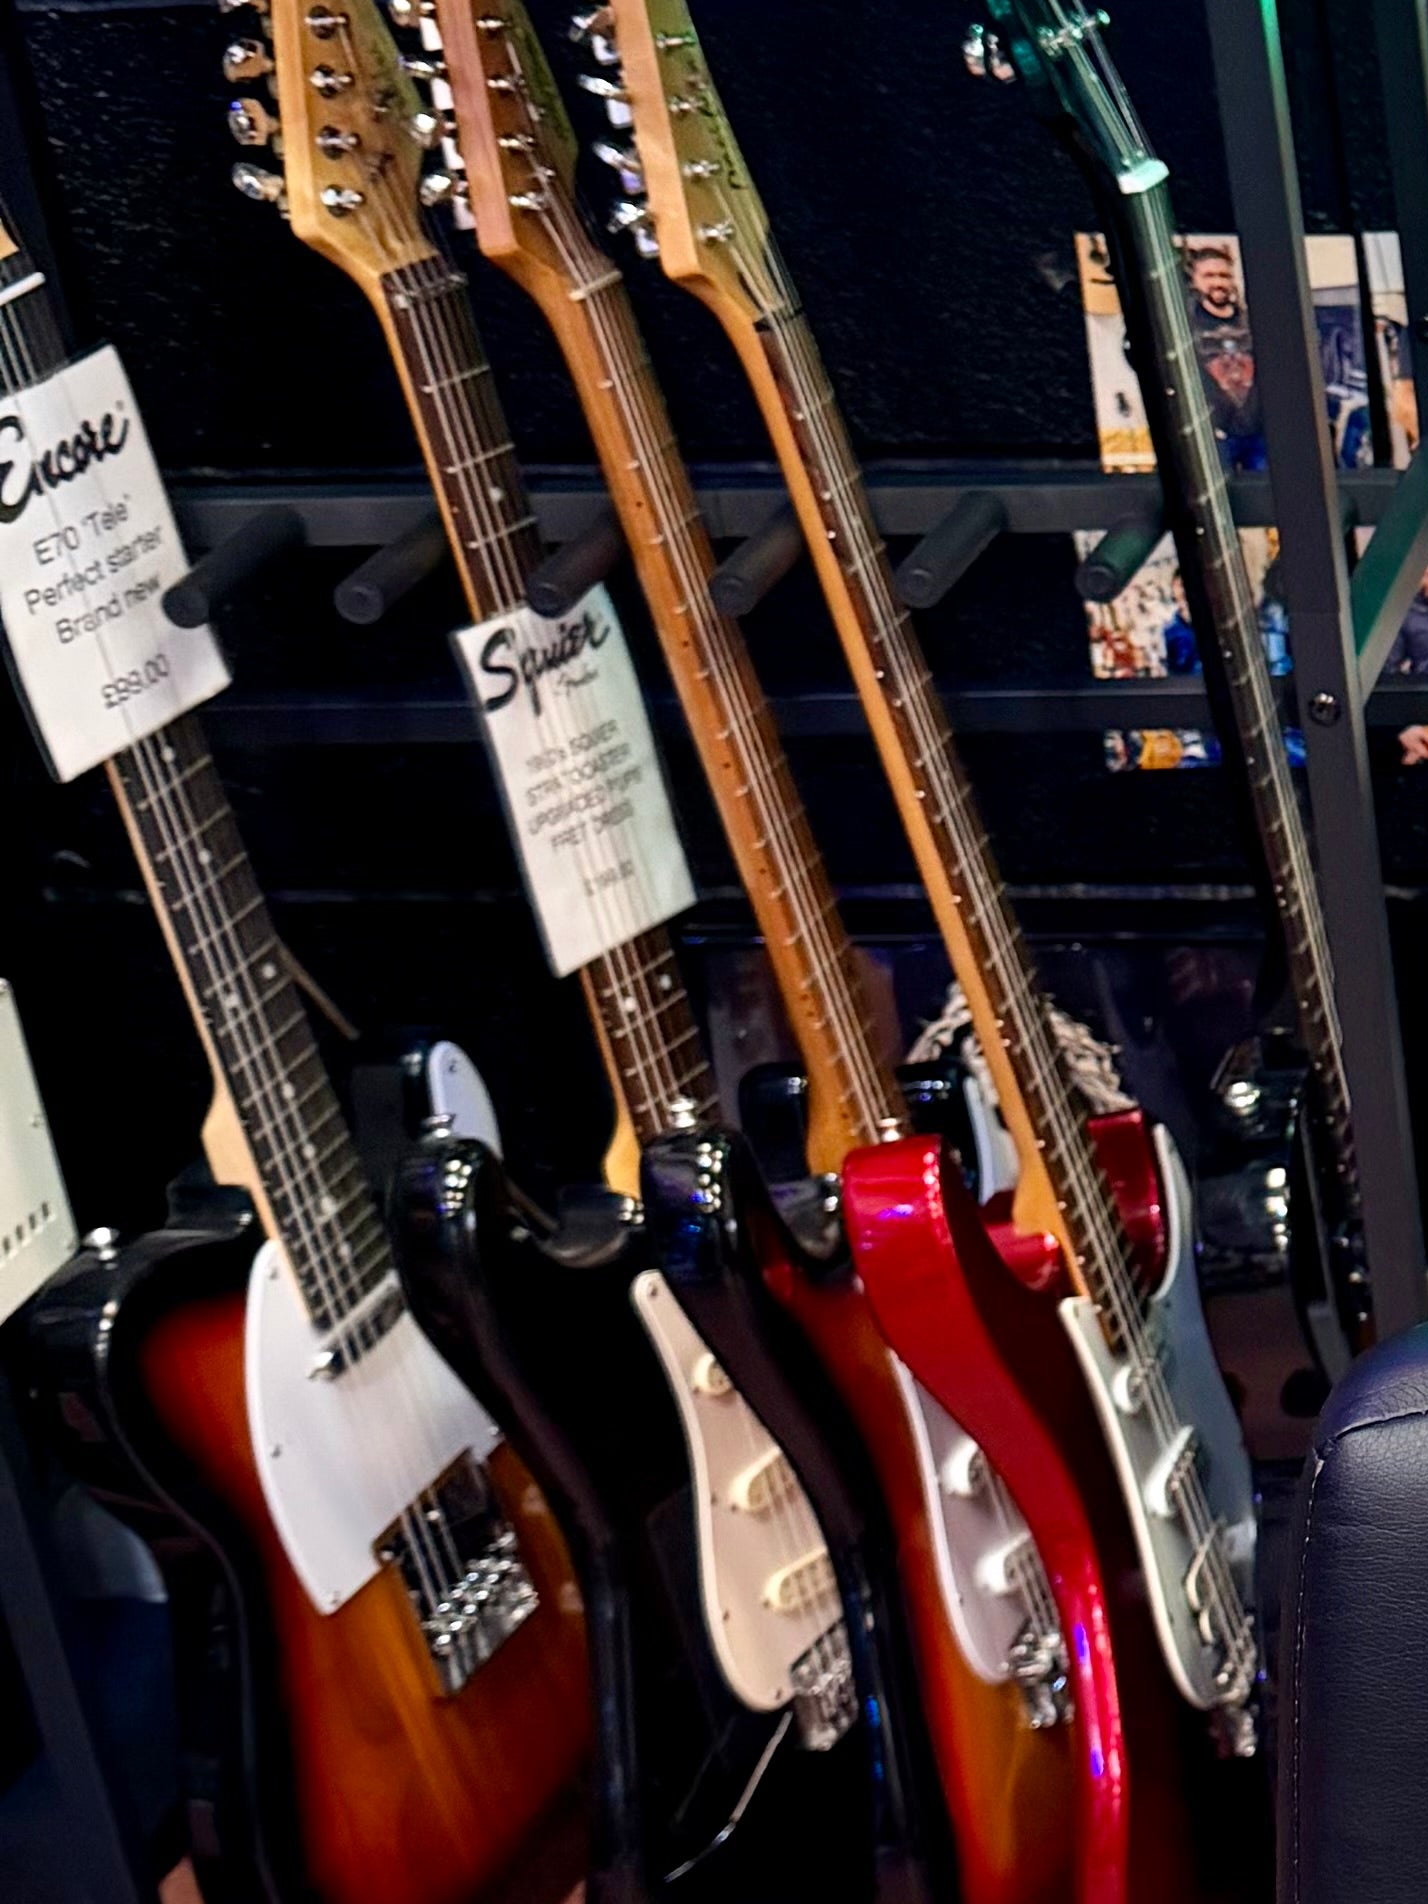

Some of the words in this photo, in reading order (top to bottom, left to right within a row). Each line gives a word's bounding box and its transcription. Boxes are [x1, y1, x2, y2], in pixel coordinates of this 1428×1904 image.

[0, 408, 131, 524] Encore
[26, 559, 105, 616] Perfect
[107, 525, 163, 577] starter
[33, 526, 80, 567] E70
[56, 595, 123, 645] Brand
[122, 576, 161, 615] new
[480, 610, 611, 718] Squier
